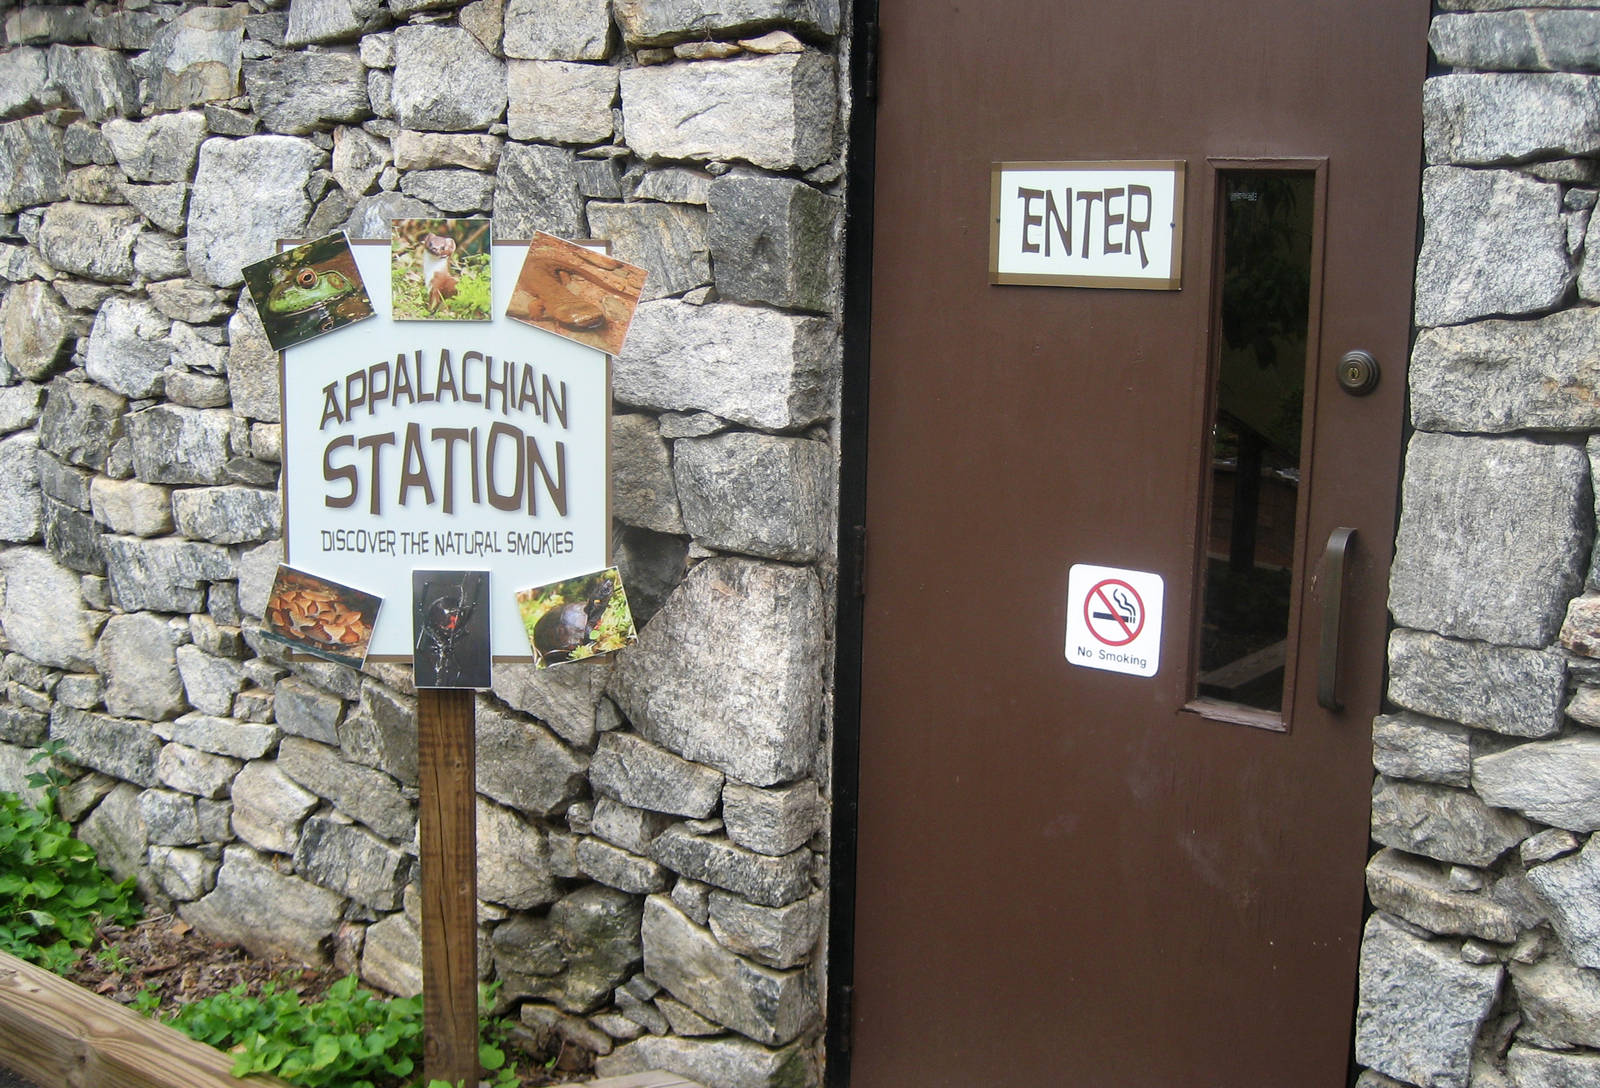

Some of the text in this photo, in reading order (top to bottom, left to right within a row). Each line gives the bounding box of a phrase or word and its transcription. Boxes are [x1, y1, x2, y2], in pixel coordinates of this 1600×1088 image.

[1017, 184, 1152, 269] ENTER
[319, 348, 568, 430] APPALACHIAN
[323, 422, 568, 517] STATION
[321, 529, 574, 557] DISCOVER THE NATURAL SMOKIES
[1077, 646, 1147, 668] No Smoking
